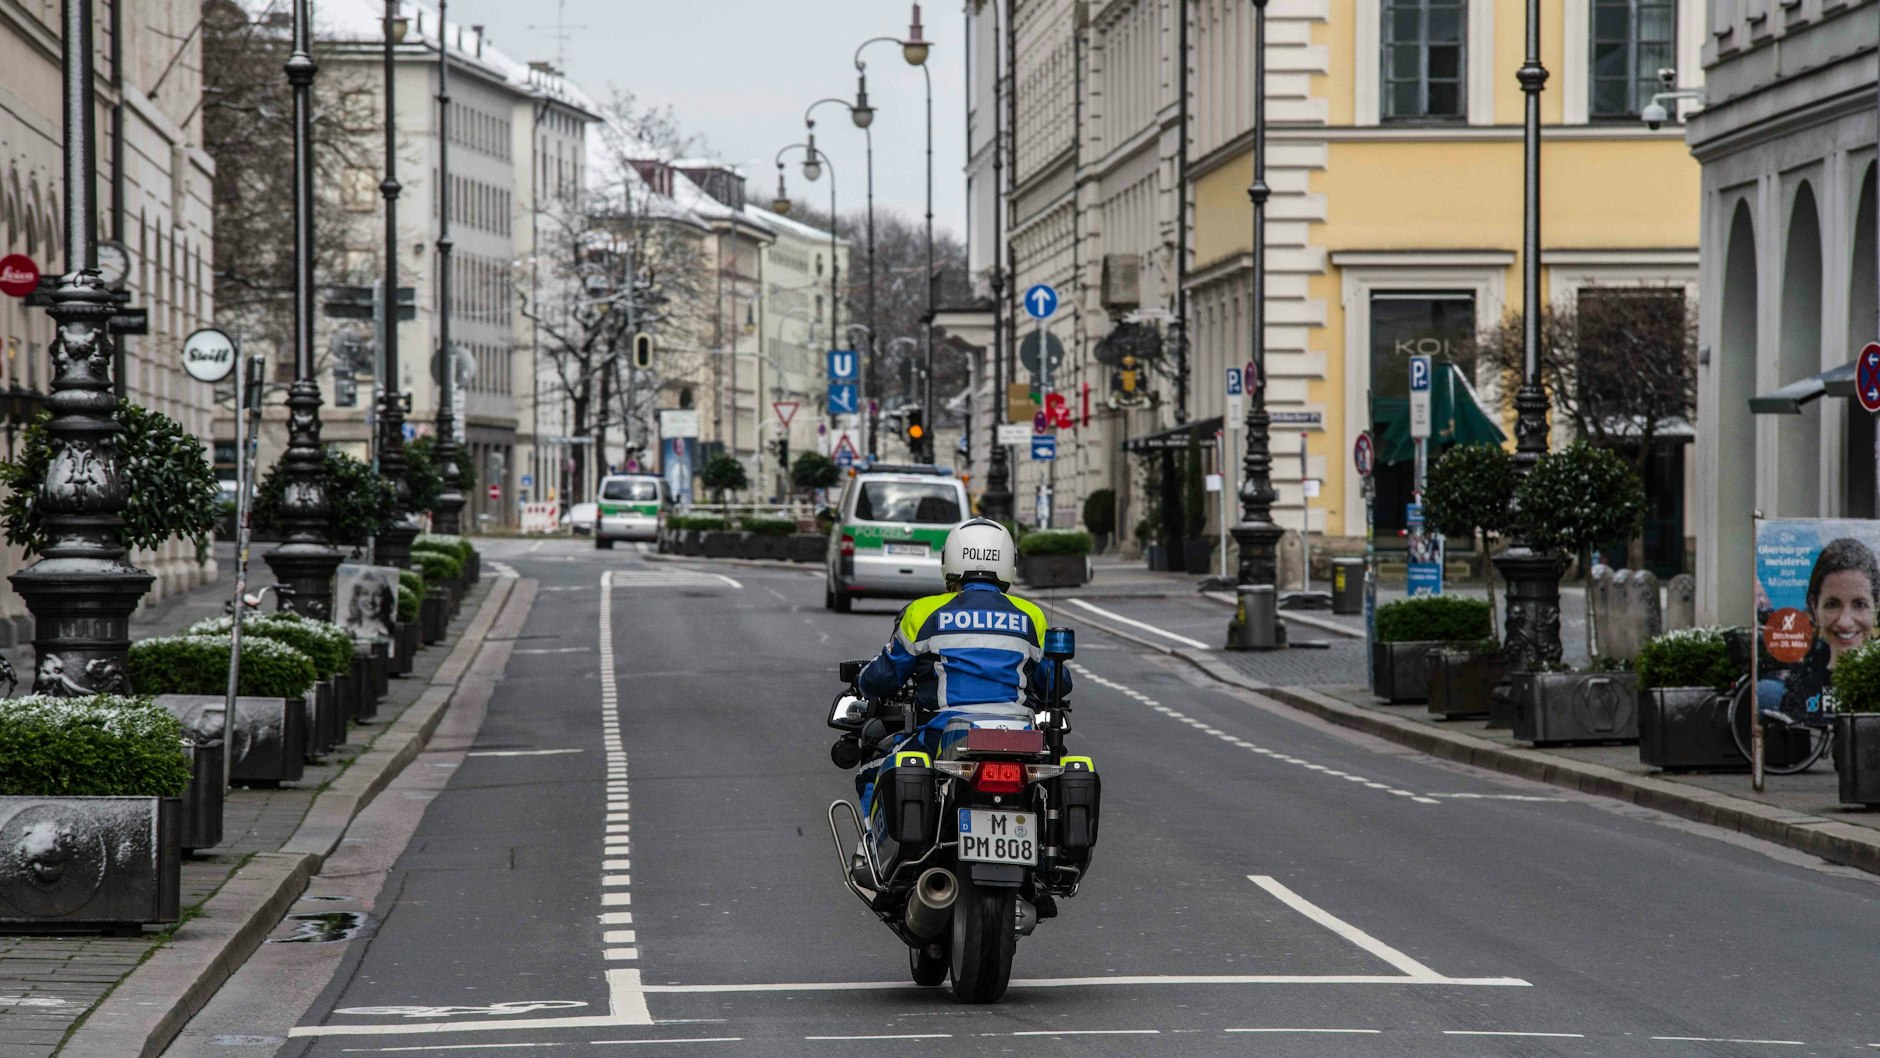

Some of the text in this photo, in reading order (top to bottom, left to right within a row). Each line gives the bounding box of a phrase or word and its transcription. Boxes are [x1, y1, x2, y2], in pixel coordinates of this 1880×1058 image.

[189, 348, 230, 363] Steiff
[833, 354, 852, 377] U
[1228, 370, 1239, 392] P
[1413, 360, 1425, 388] P
[962, 547, 1001, 562] POLIZEI
[939, 610, 1029, 633] POLIZEI
[962, 823, 969, 831] D
[991, 814, 1007, 835] M
[962, 836, 1033, 861] PM 808
